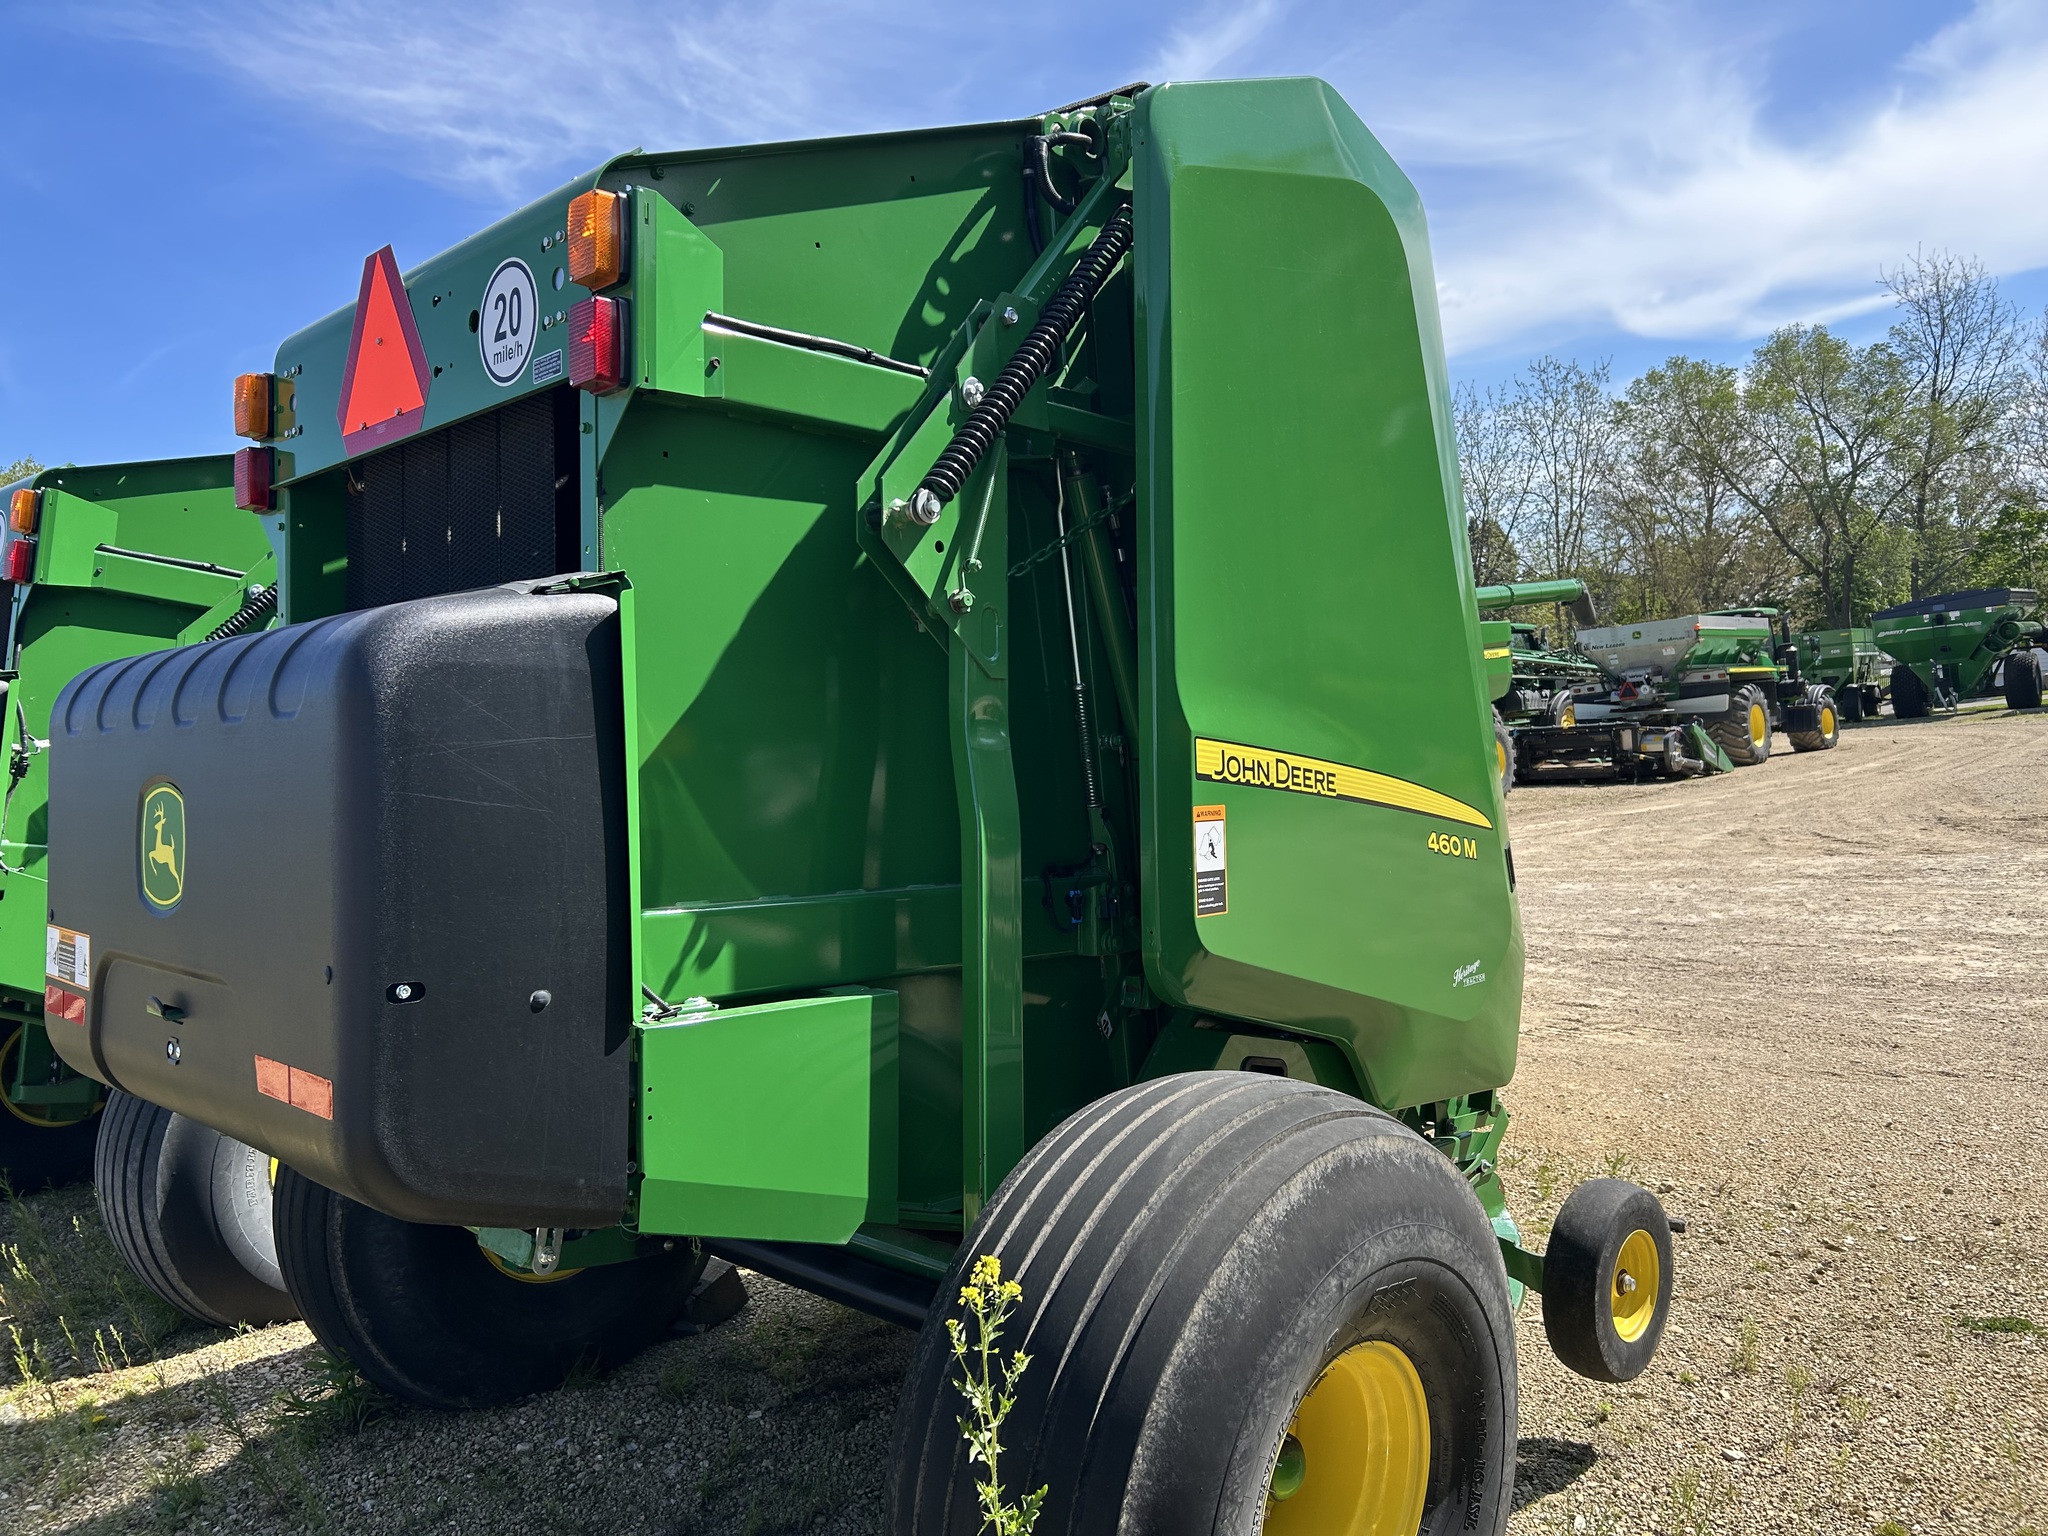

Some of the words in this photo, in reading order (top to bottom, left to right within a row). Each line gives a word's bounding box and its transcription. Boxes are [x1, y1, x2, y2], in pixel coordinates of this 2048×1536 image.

[494, 287, 522, 343] 20
[493, 341, 523, 365] mile/h
[1214, 749, 1270, 783] JOHN
[1276, 758, 1337, 794] DEERE
[1200, 809, 1222, 817] WARNING
[1427, 831, 1461, 857] 460
[1463, 839, 1478, 860] M
[1453, 959, 1480, 987] Heritage
